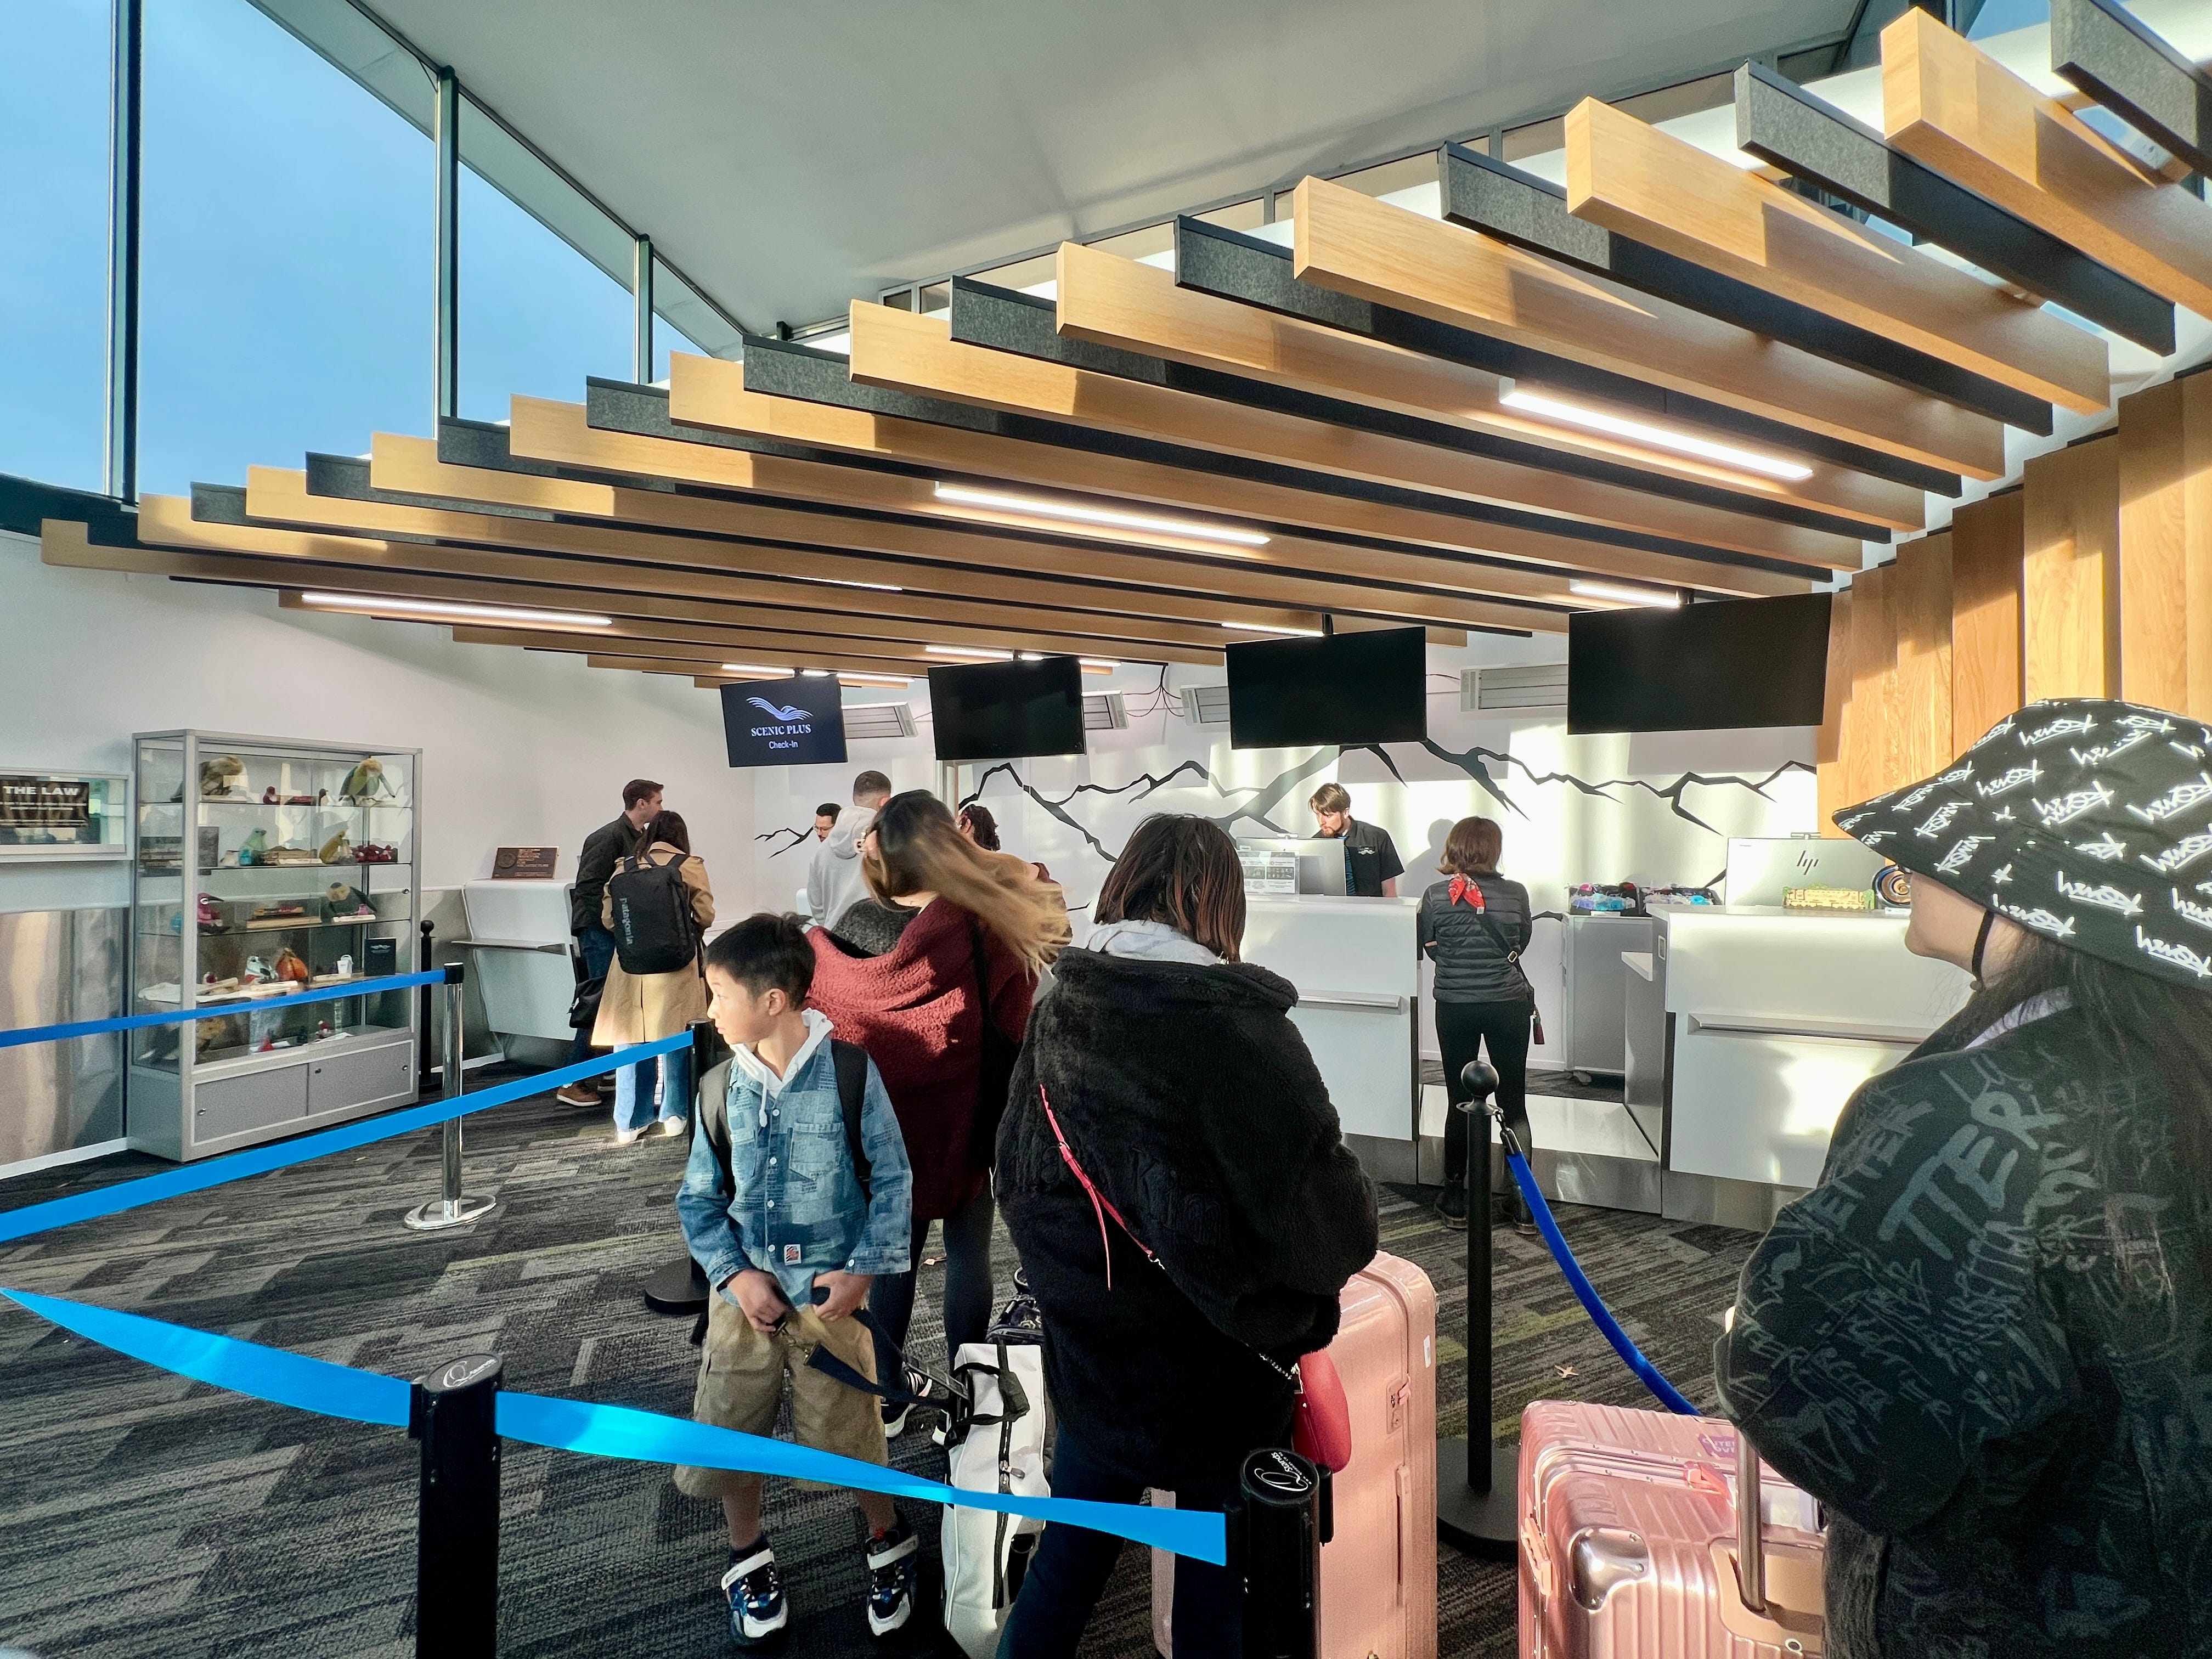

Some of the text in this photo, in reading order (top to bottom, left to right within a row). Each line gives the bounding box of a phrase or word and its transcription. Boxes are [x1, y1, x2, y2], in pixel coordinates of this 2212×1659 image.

[751, 724, 812, 736] SCENIC PLUS
[769, 740, 799, 750] Check-In
[2, 786, 79, 795] THE LAW
[1796, 850, 1819, 876] hp
[619, 897, 634, 945] patagonia
